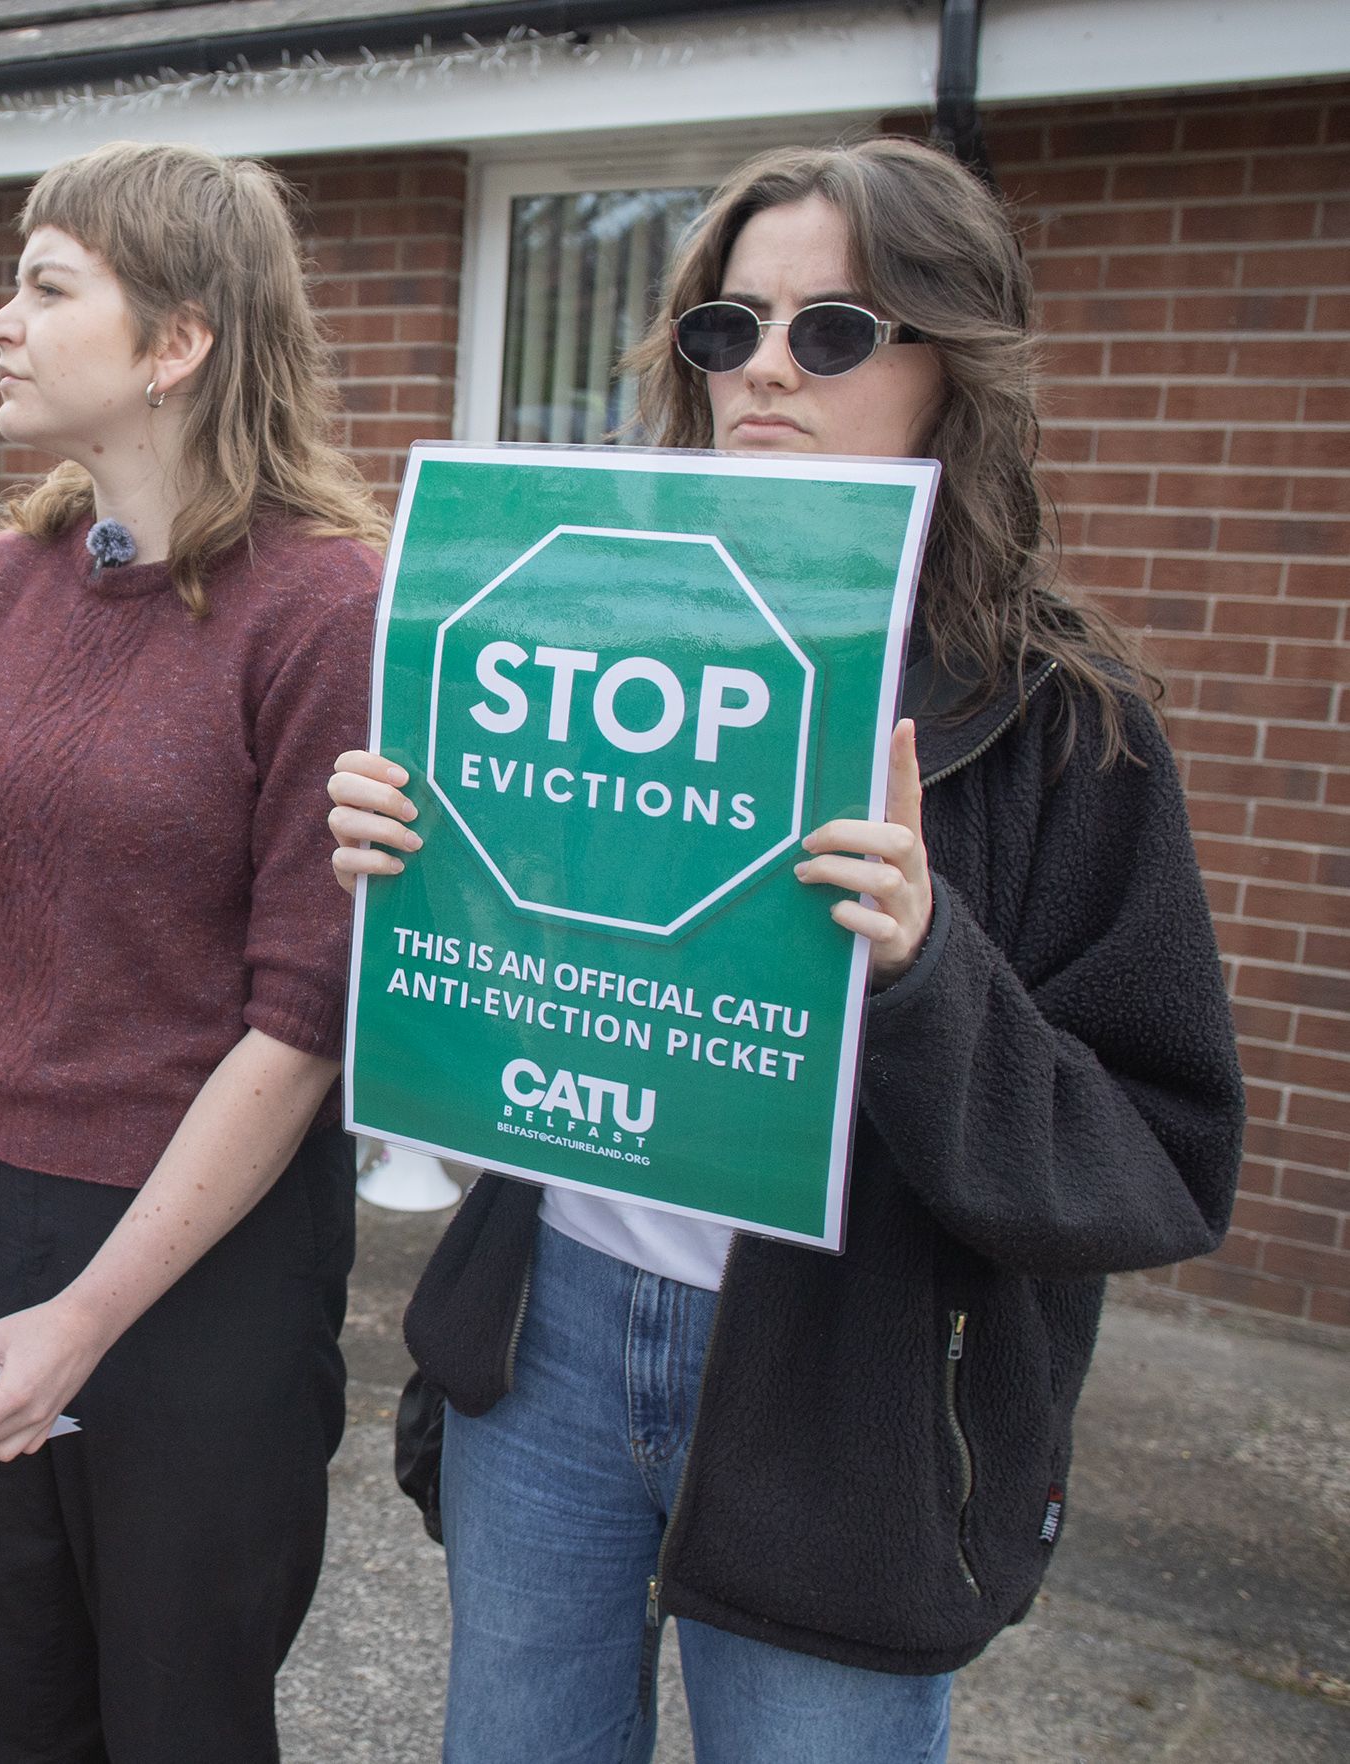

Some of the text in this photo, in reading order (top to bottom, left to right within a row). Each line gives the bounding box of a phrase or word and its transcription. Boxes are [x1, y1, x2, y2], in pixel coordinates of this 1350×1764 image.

[469, 640, 770, 763] STOP
[461, 752, 756, 830] EVICTIONS
[393, 927, 809, 1039] THIS IS AN OFFICIAL CATU
[387, 967, 805, 1082] ANTI-EVICTION PICKET
[501, 1058, 657, 1134] CATU
[503, 1105, 647, 1149] BELFAST
[497, 1121, 651, 1166] BELFAST@CATUIRELAND.ORG
